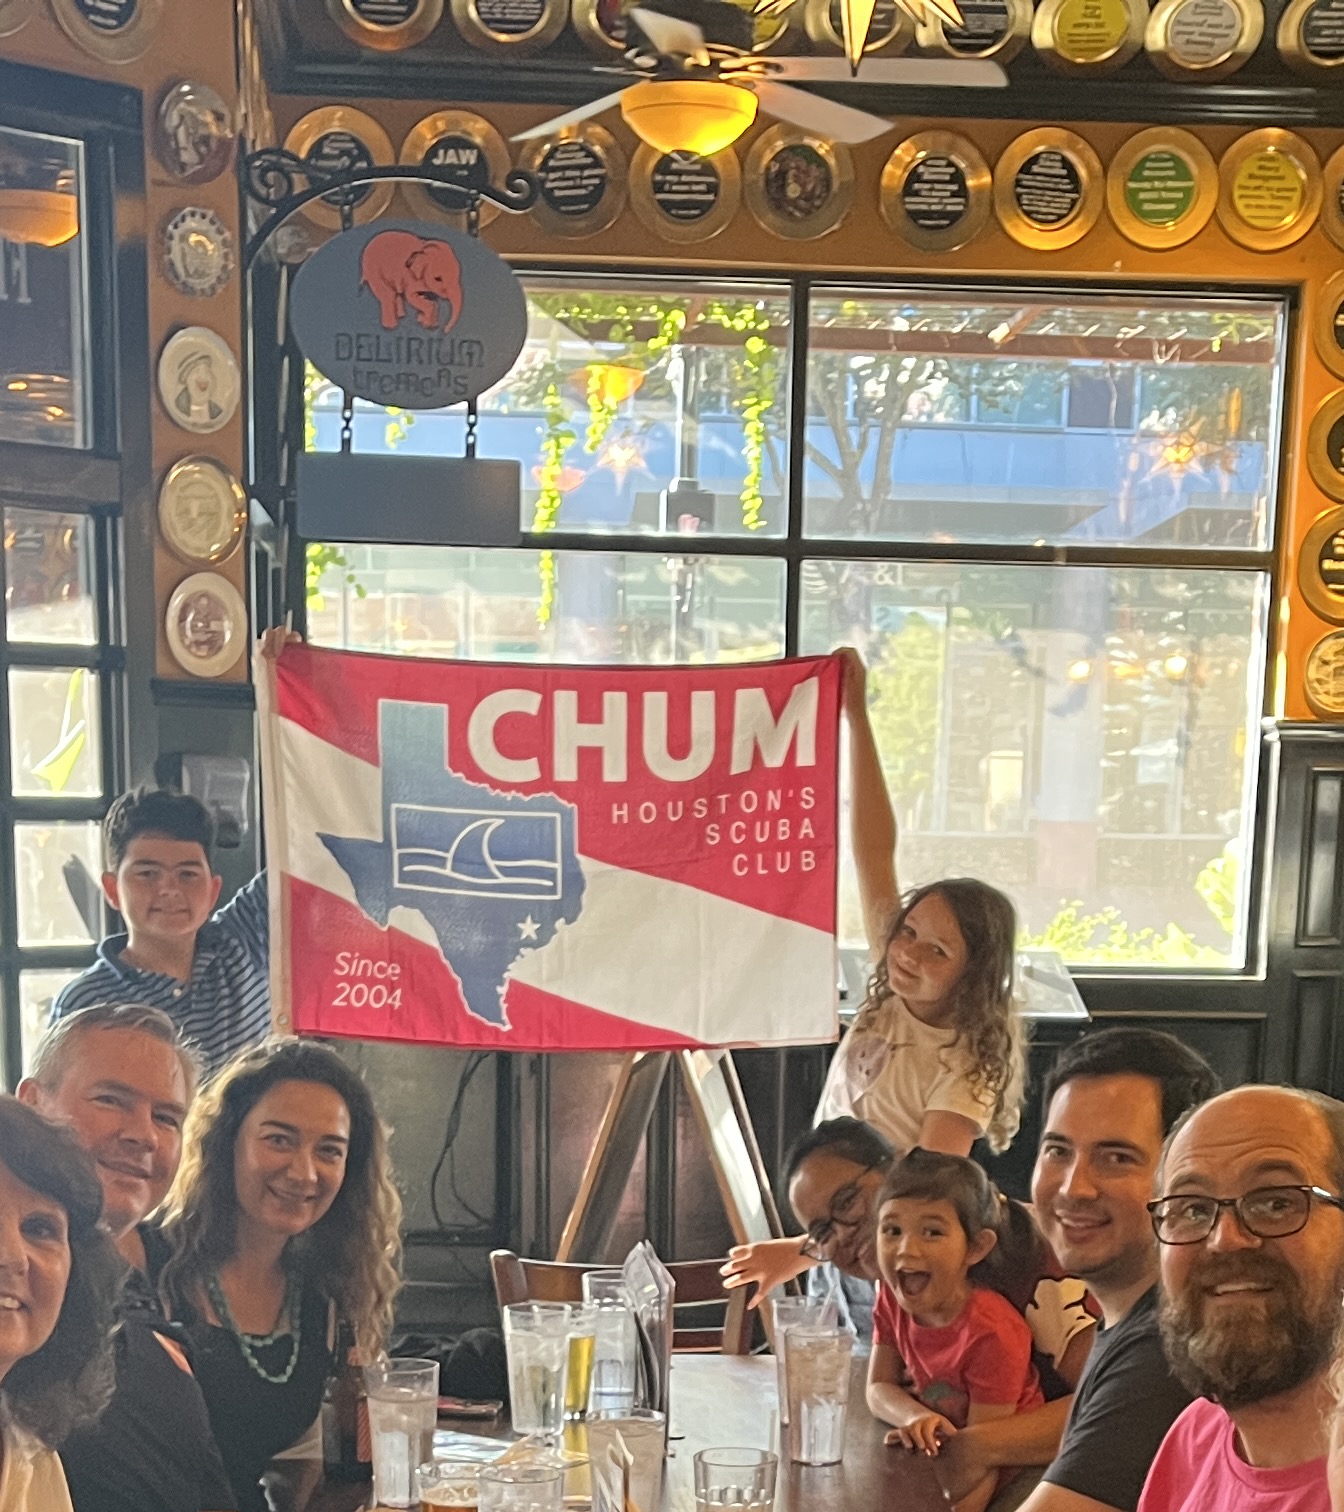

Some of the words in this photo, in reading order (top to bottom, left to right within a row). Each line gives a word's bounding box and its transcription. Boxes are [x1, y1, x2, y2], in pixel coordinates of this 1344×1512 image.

[335, 332, 485, 368] DELIRIUM
[467, 675, 821, 784] CHUM
[611, 786, 818, 826] HOUSTON'S
[706, 816, 816, 847] SCUBA
[731, 850, 818, 878] CLUB
[333, 951, 402, 982] Since
[331, 981, 403, 1010] 2004
